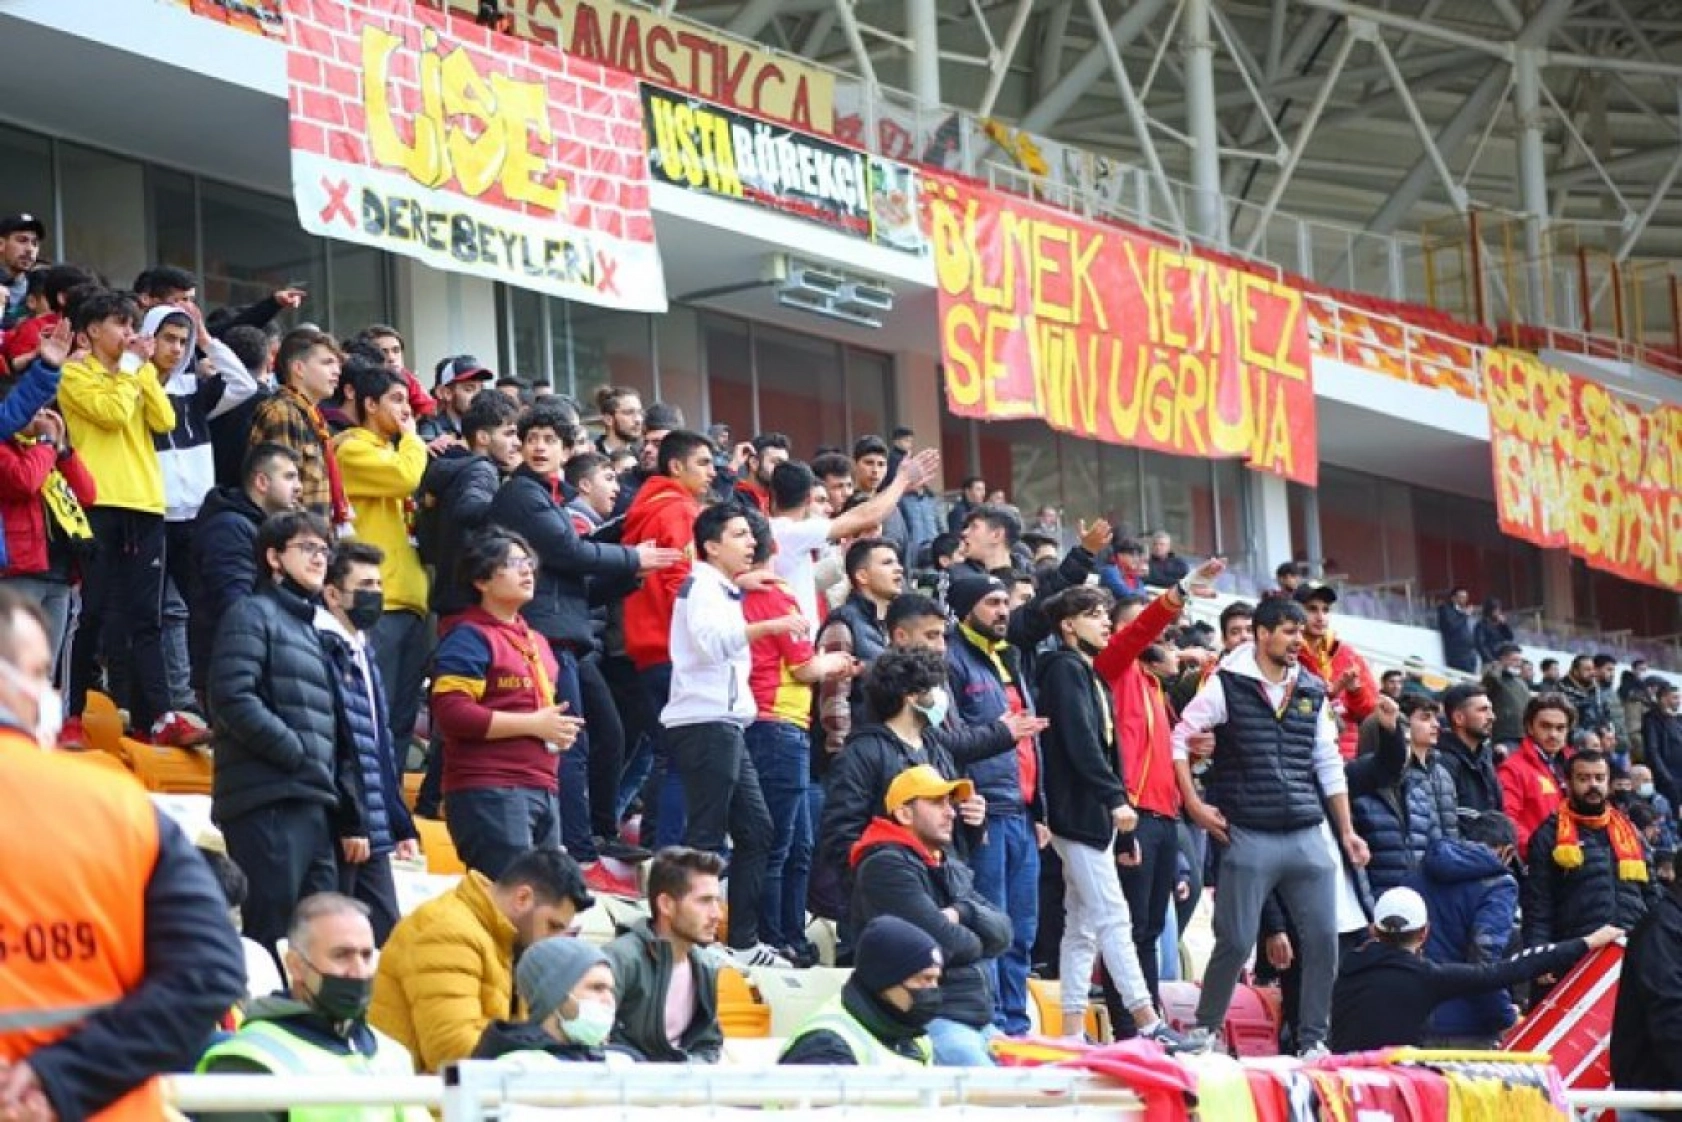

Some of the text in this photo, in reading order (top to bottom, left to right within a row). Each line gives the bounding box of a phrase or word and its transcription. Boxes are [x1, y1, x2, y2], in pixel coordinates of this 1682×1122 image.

[651, 95, 744, 197] USTA
[925, 179, 1308, 382] ÖLMEK YETMEZ
